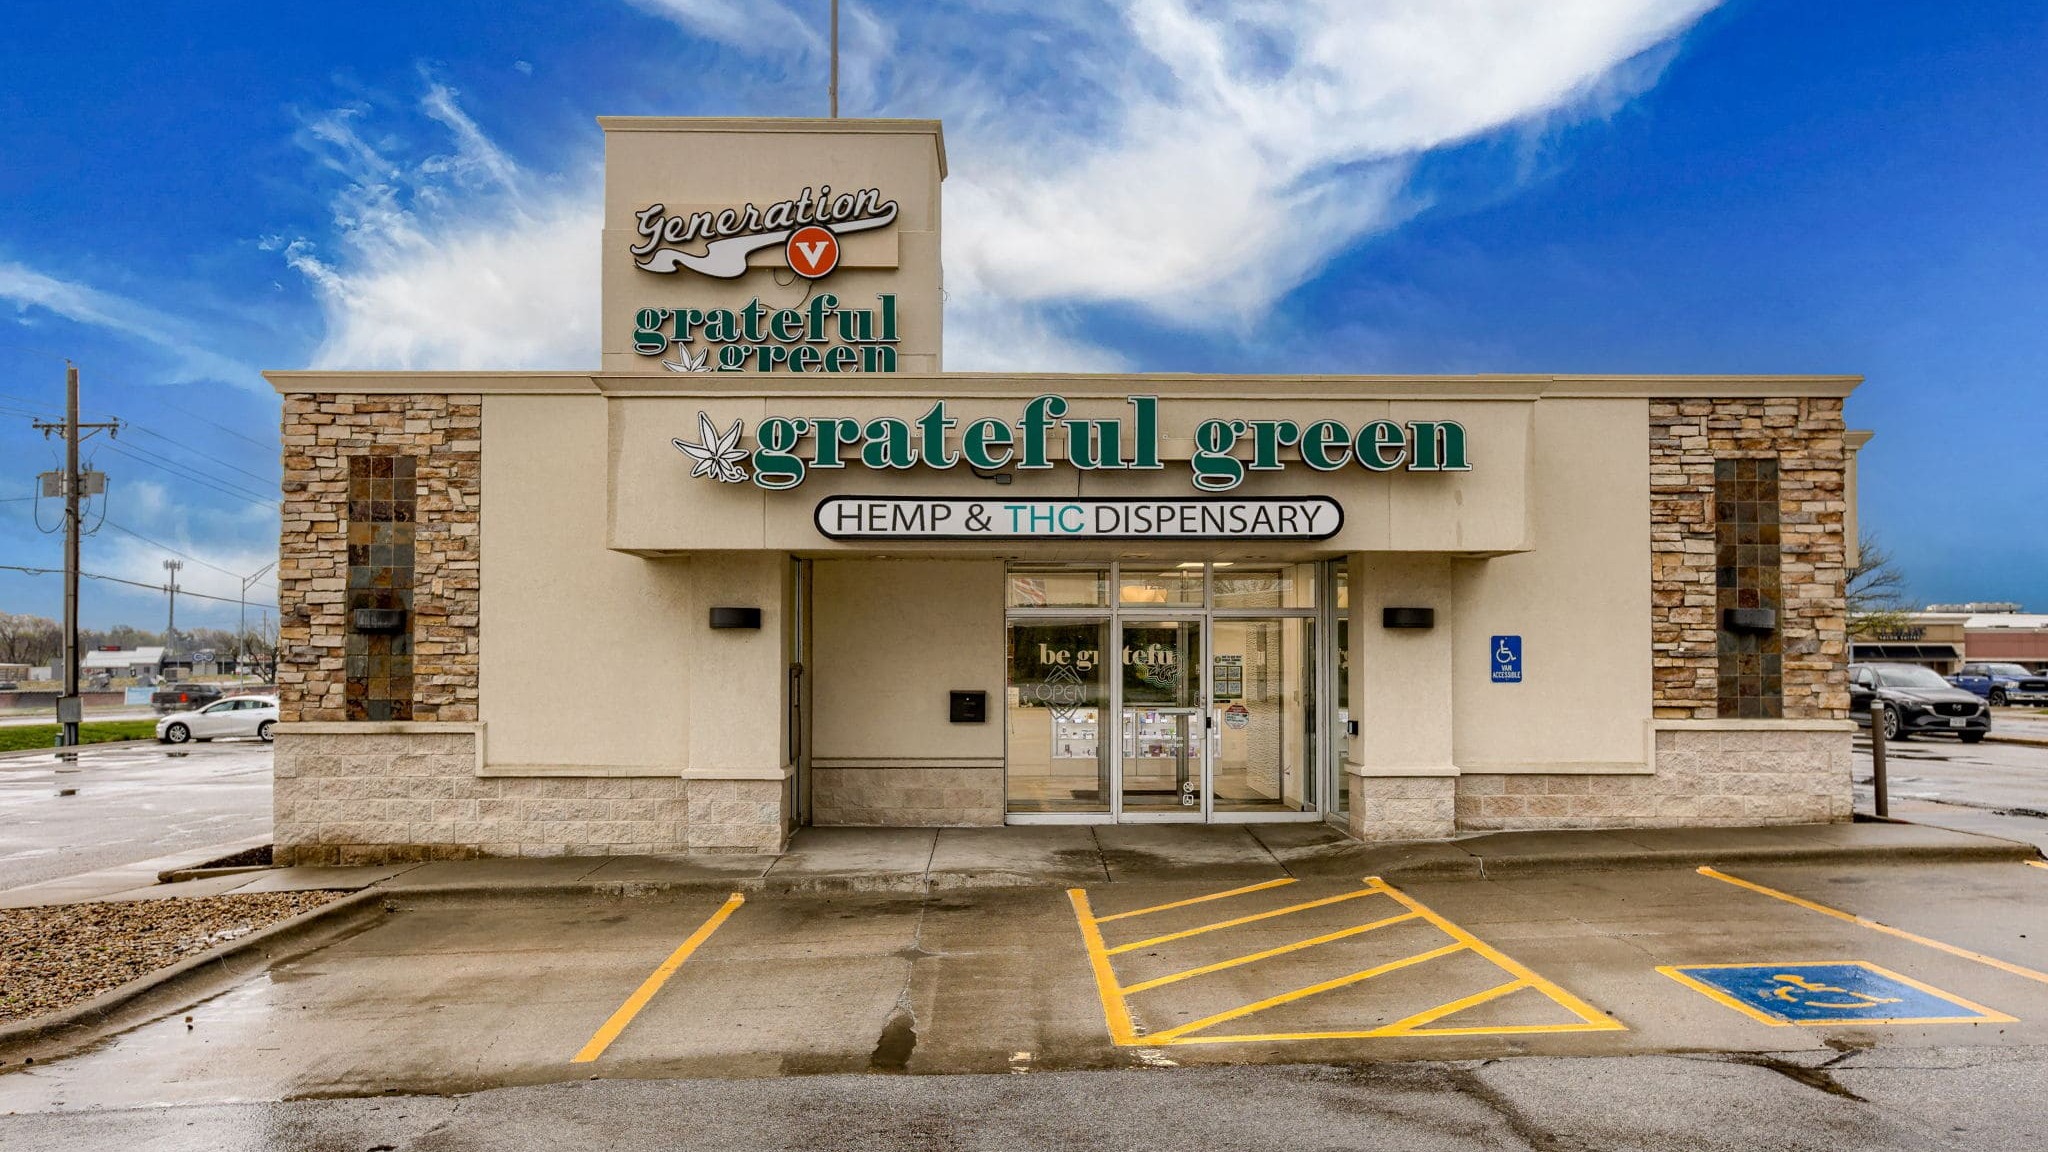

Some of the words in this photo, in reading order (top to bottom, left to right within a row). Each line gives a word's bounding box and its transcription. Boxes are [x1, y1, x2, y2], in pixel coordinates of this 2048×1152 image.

[630, 185, 897, 255] Generation
[796, 241, 829, 269] V
[632, 292, 900, 355] grateful
[716, 344, 898, 372] green
[752, 394, 1164, 490] grateful
[1191, 419, 1473, 491] green
[837, 503, 952, 531] HEMP
[964, 503, 992, 532] &
[1003, 505, 1085, 533] THC
[1095, 505, 1322, 533] DISPENSARY
[1038, 643, 1070, 665] be
[1036, 684, 1086, 700] OPEN
